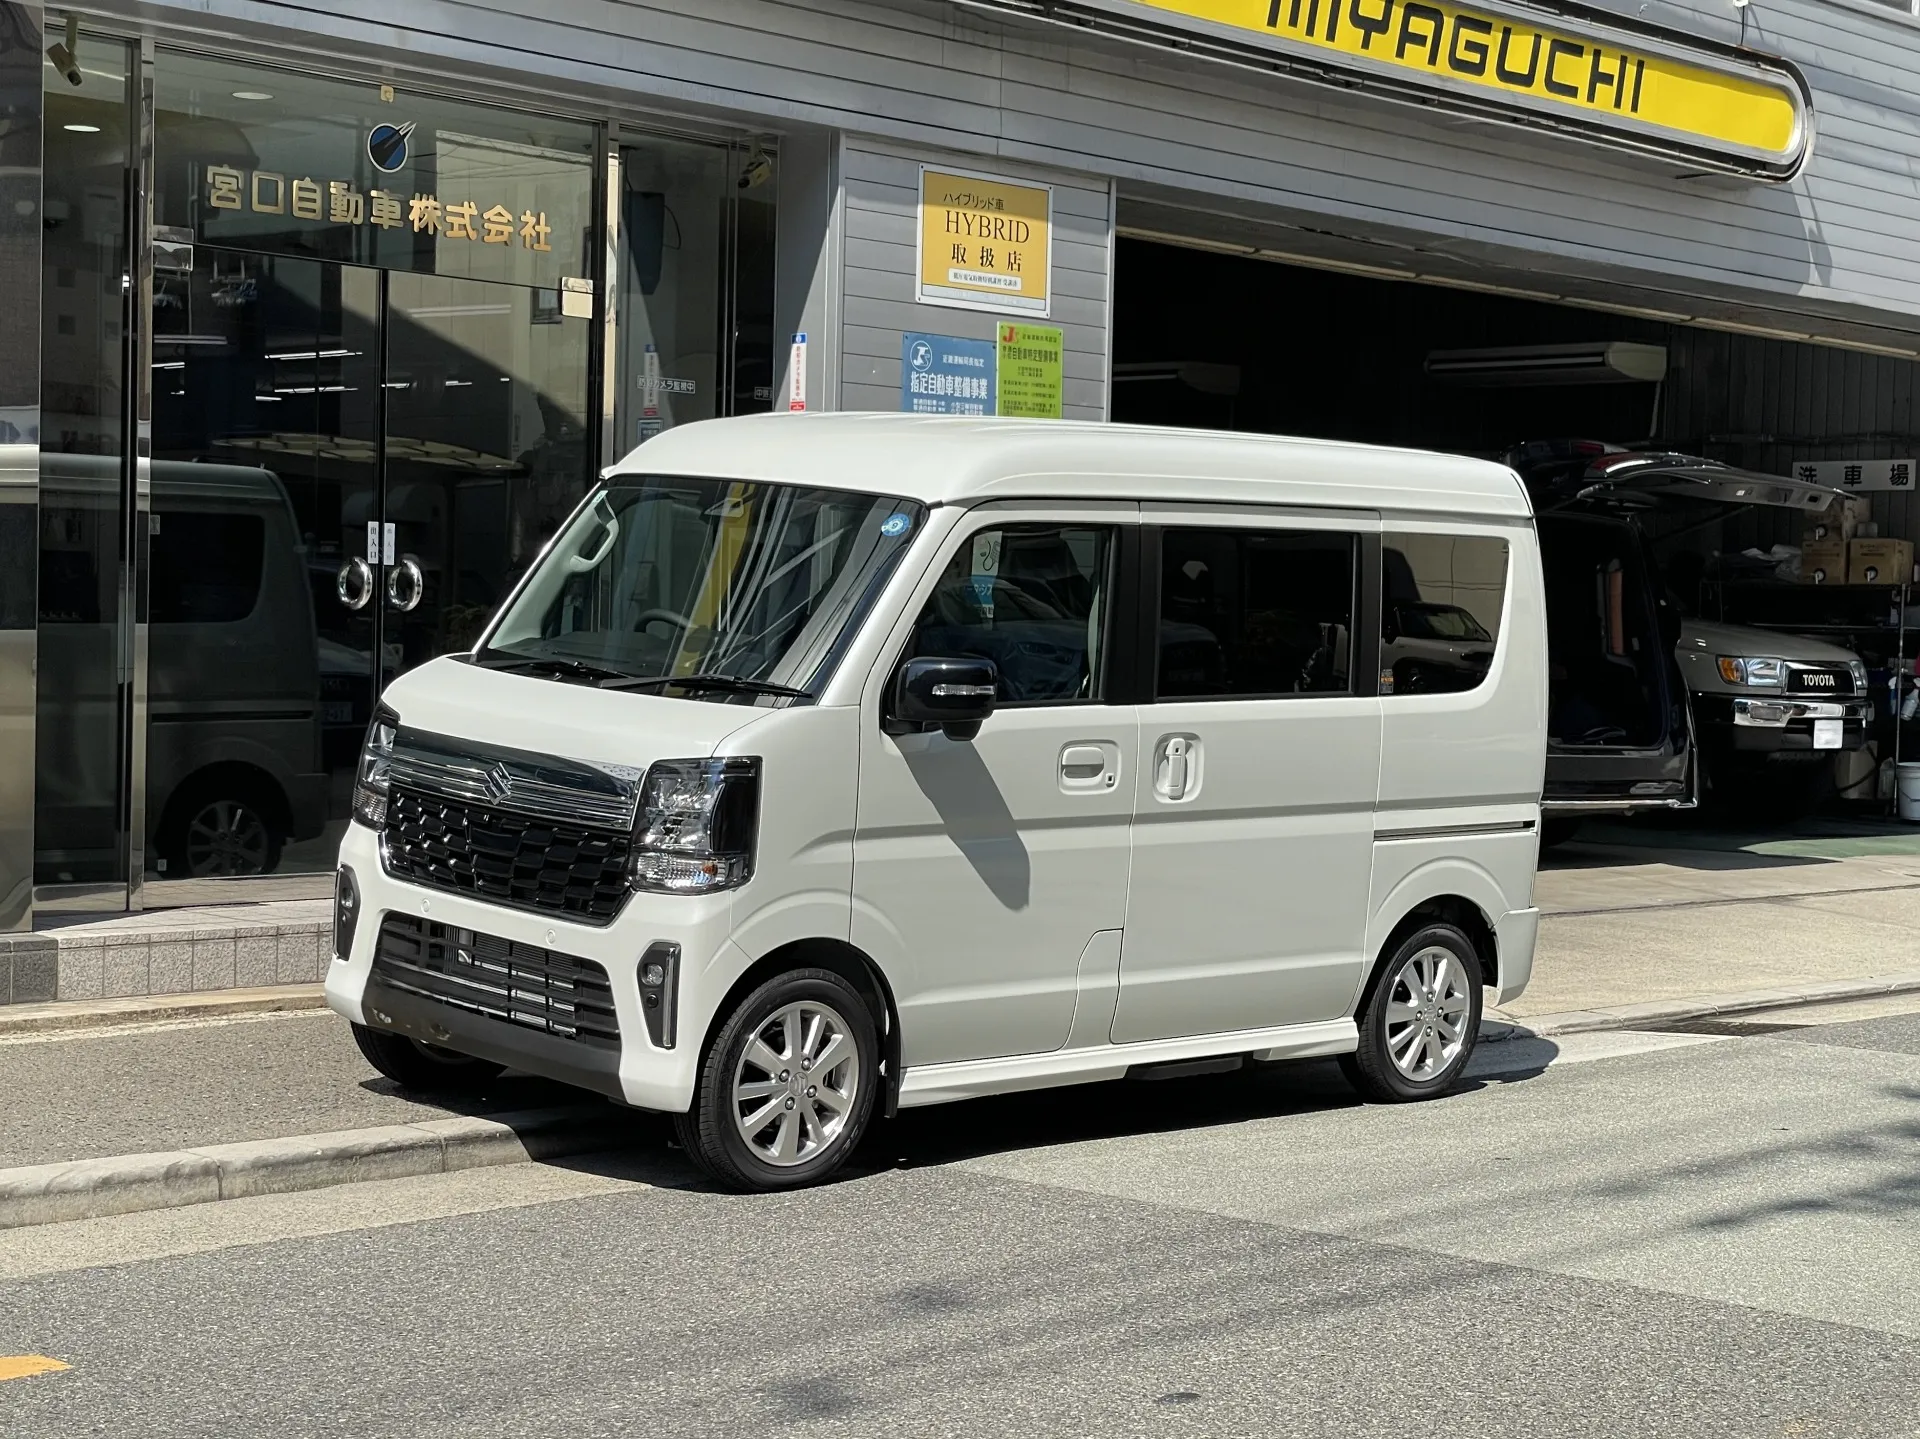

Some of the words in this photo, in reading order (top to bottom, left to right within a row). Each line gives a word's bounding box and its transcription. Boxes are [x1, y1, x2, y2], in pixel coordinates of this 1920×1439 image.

[207, 164, 552, 252] 宮口自動車株式会社
[943, 193, 1004, 210] ハイブリッド車
[945, 210, 1029, 243] HYBRID
[952, 243, 1021, 272] 取扱店
[911, 371, 987, 399] 指定自動車整備事業
[1799, 464, 1909, 487] 洗車場
[1802, 674, 1835, 686] TOYOTA
